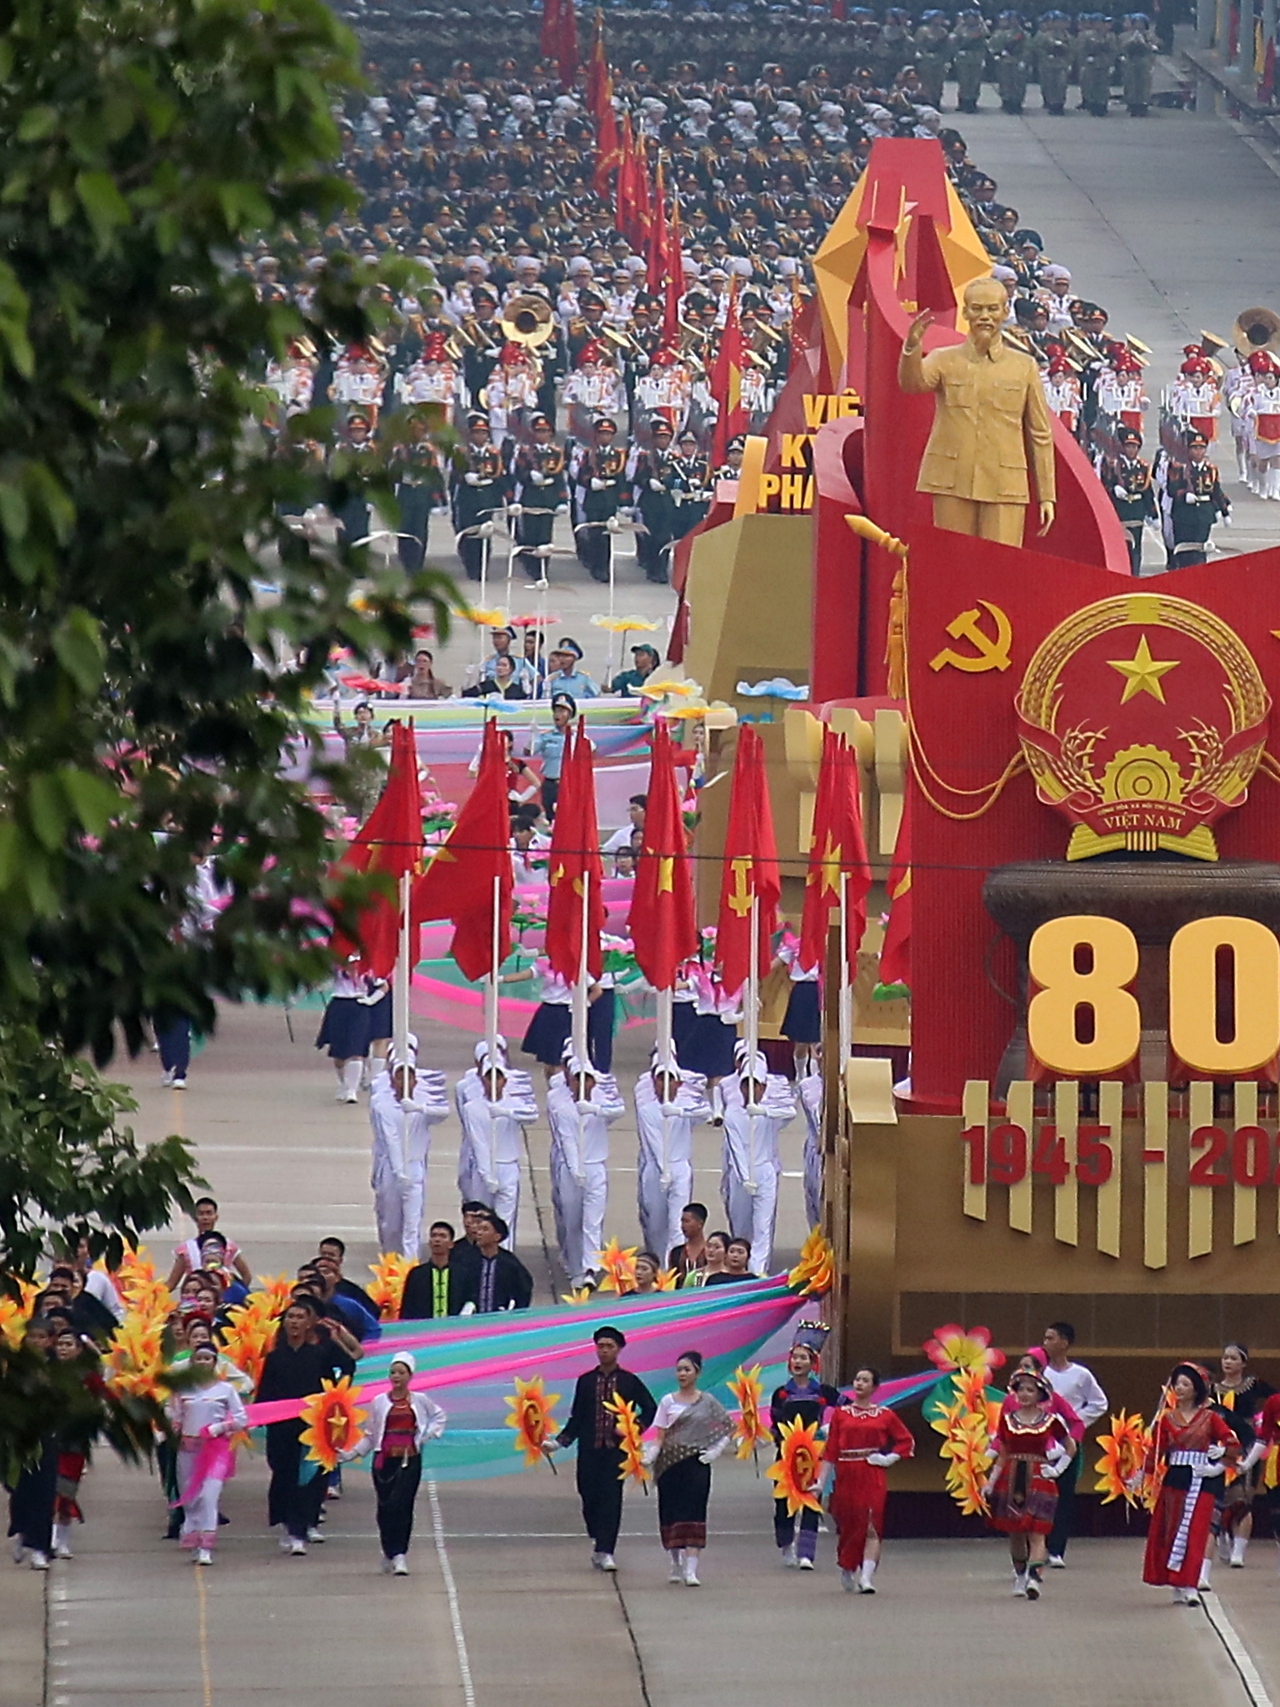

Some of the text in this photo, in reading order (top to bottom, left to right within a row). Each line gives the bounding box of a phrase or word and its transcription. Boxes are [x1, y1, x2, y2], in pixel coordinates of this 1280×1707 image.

[1103, 811, 1182, 830] VIỆT NAM
[960, 1124, 1114, 1186] 1945
